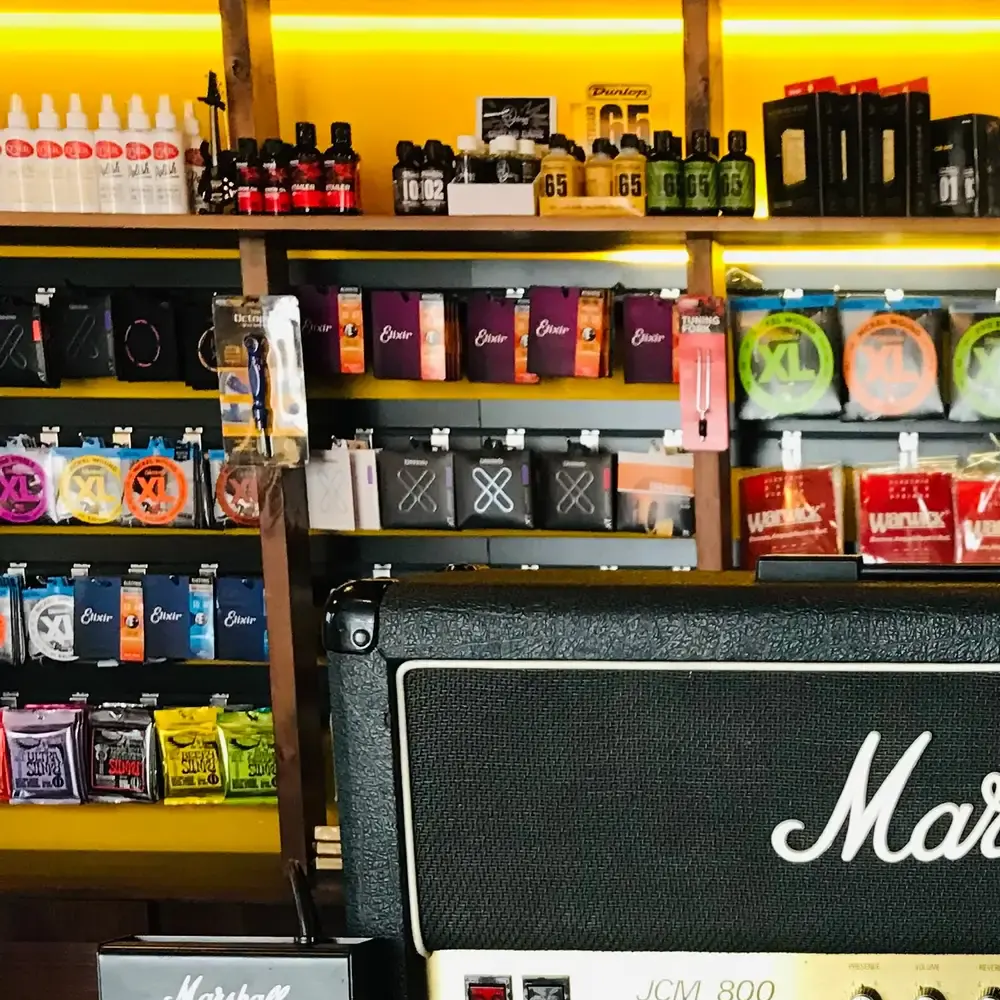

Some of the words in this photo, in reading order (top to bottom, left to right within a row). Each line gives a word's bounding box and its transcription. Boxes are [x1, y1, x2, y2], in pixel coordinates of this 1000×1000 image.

[591, 86, 649, 99] Dunlop
[545, 174, 568, 197] 65
[619, 174, 642, 197] 65
[687, 173, 709, 198] 65
[379, 325, 413, 344] Elixir
[475, 328, 508, 347] Elixir
[535, 318, 570, 338] Elixir
[631, 327, 665, 347] Elixir
[757, 342, 817, 384] XL
[861, 345, 921, 384] XL
[0, 474, 40, 503] XL
[72, 474, 117, 503] XL
[136, 476, 176, 503] XL
[81, 607, 113, 625] Elixir
[150, 605, 182, 624] Elixir
[224, 609, 256, 628] Elixir
